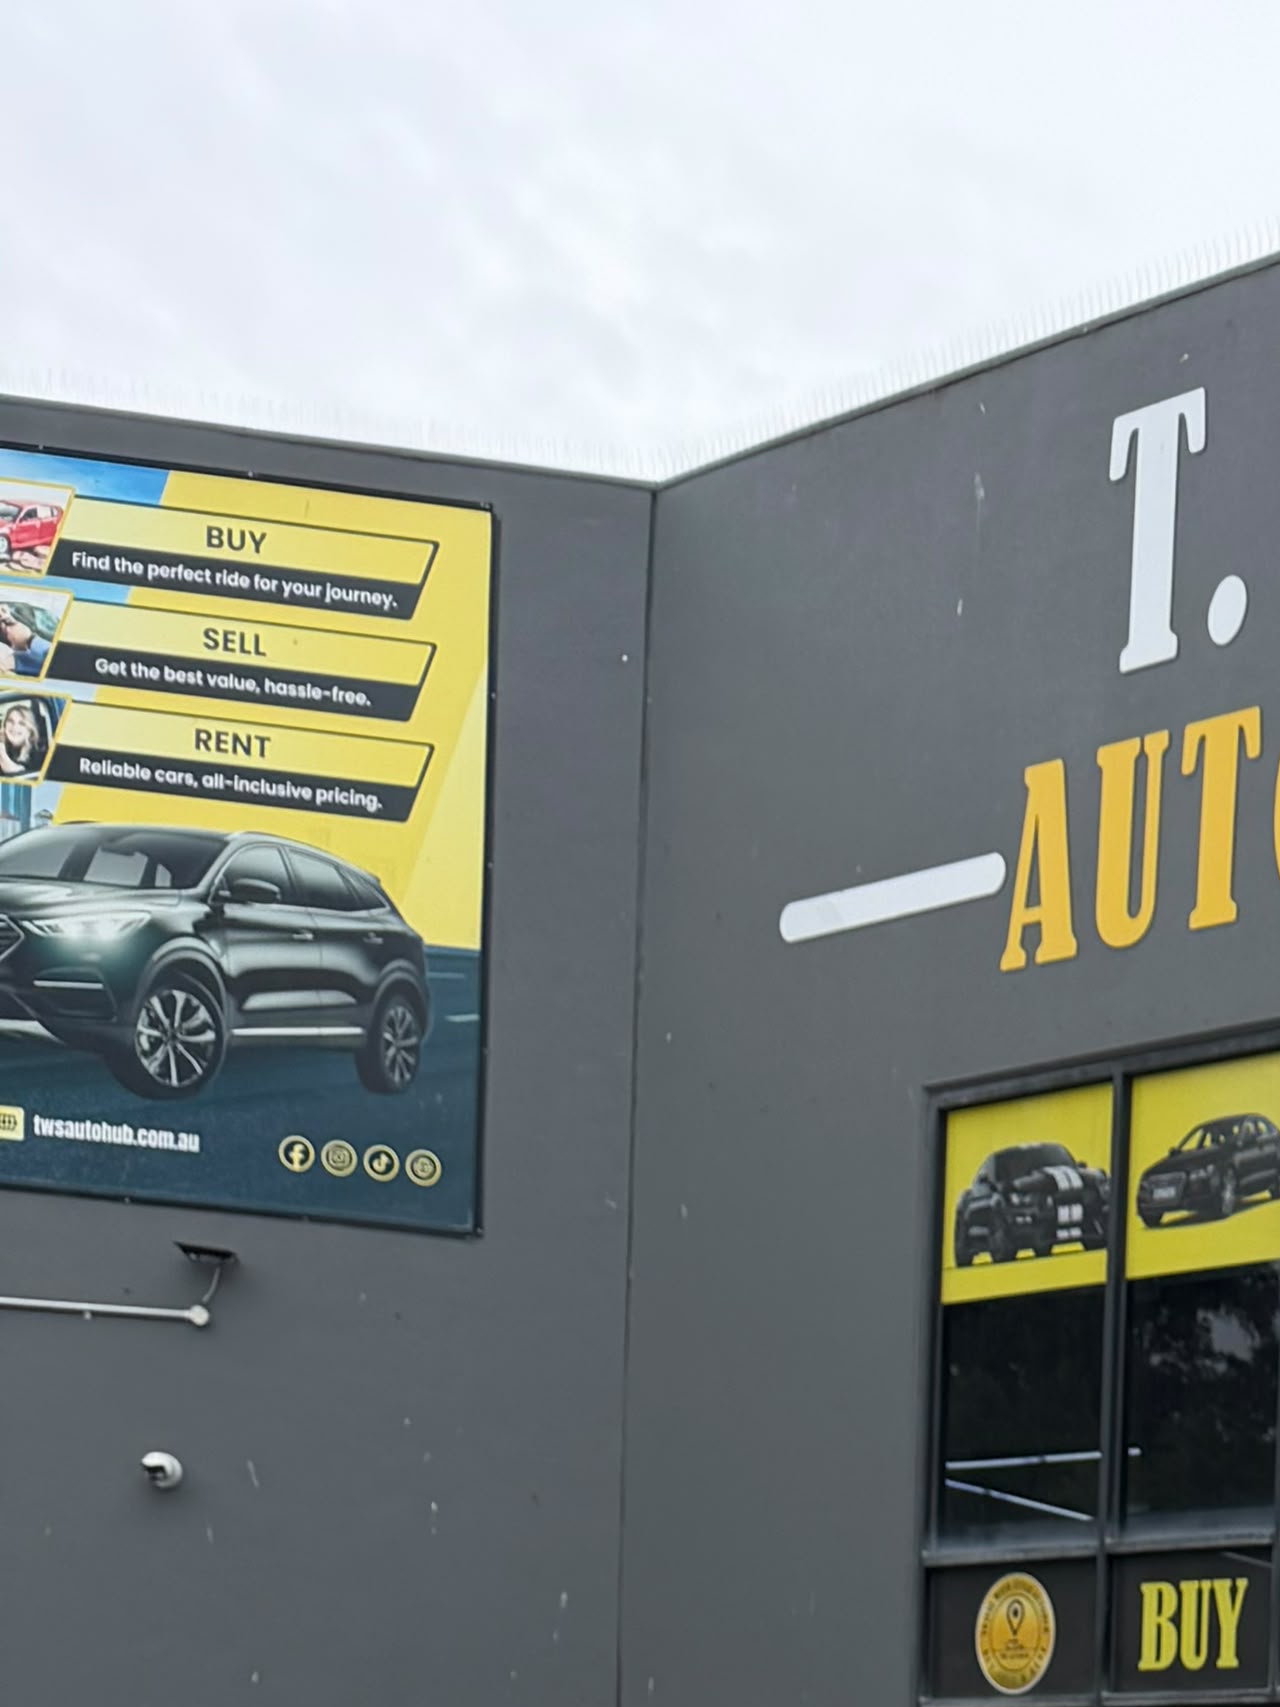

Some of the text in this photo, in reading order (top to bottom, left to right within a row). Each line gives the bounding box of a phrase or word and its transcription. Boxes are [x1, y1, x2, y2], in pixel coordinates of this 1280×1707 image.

[205, 525, 267, 555] BUY
[71, 551, 398, 609] Find the perfect ride for your journey.
[202, 627, 267, 657] SELL
[95, 658, 372, 708] Get the best value, hassle-free.
[194, 728, 271, 759] RENT
[79, 757, 383, 812] Reliable cars, all-inclusive pricing.
[33, 1113, 200, 1153] twsautohub.com.au
[1137, 1577, 1249, 1671] BUY
